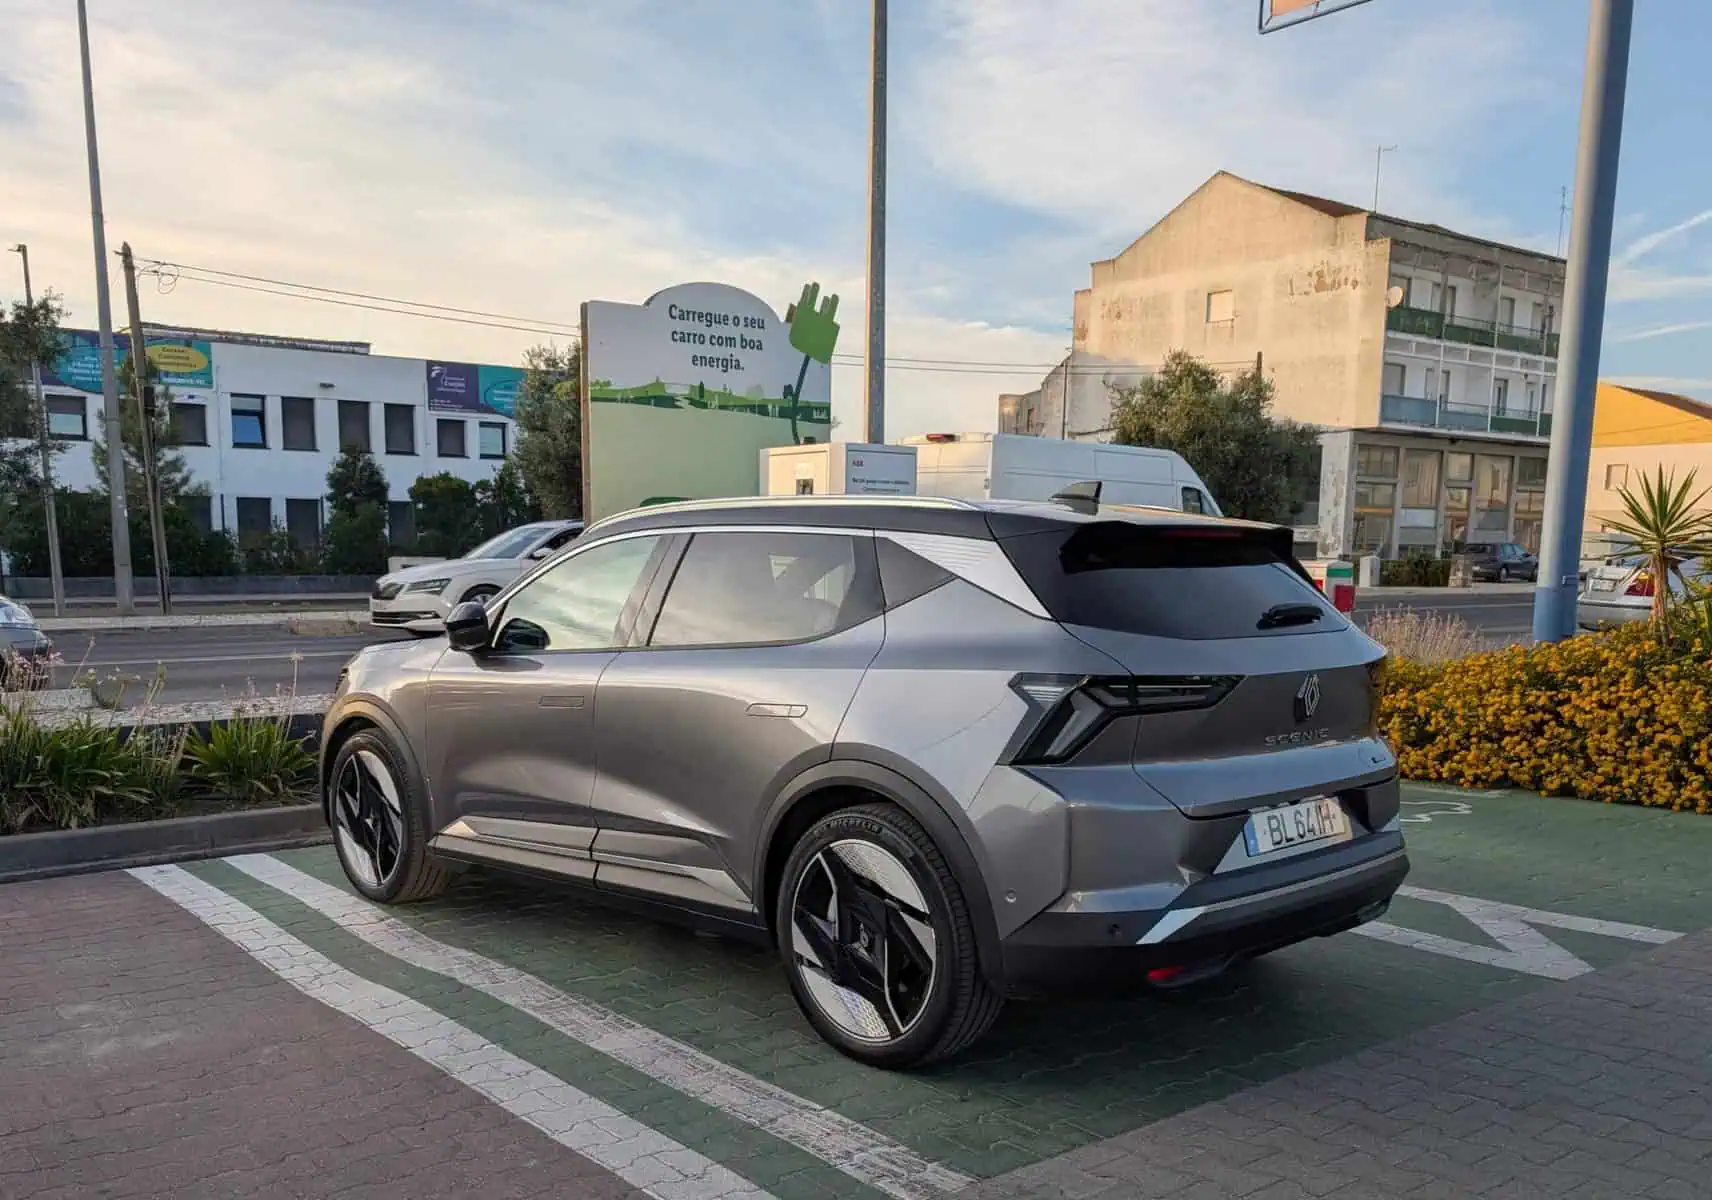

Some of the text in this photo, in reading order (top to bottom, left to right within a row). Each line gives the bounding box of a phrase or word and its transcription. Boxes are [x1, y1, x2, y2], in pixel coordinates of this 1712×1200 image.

[668, 303, 765, 330] Carregue o seu
[671, 330, 763, 351] carro com boa
[692, 353, 744, 373] energia.
